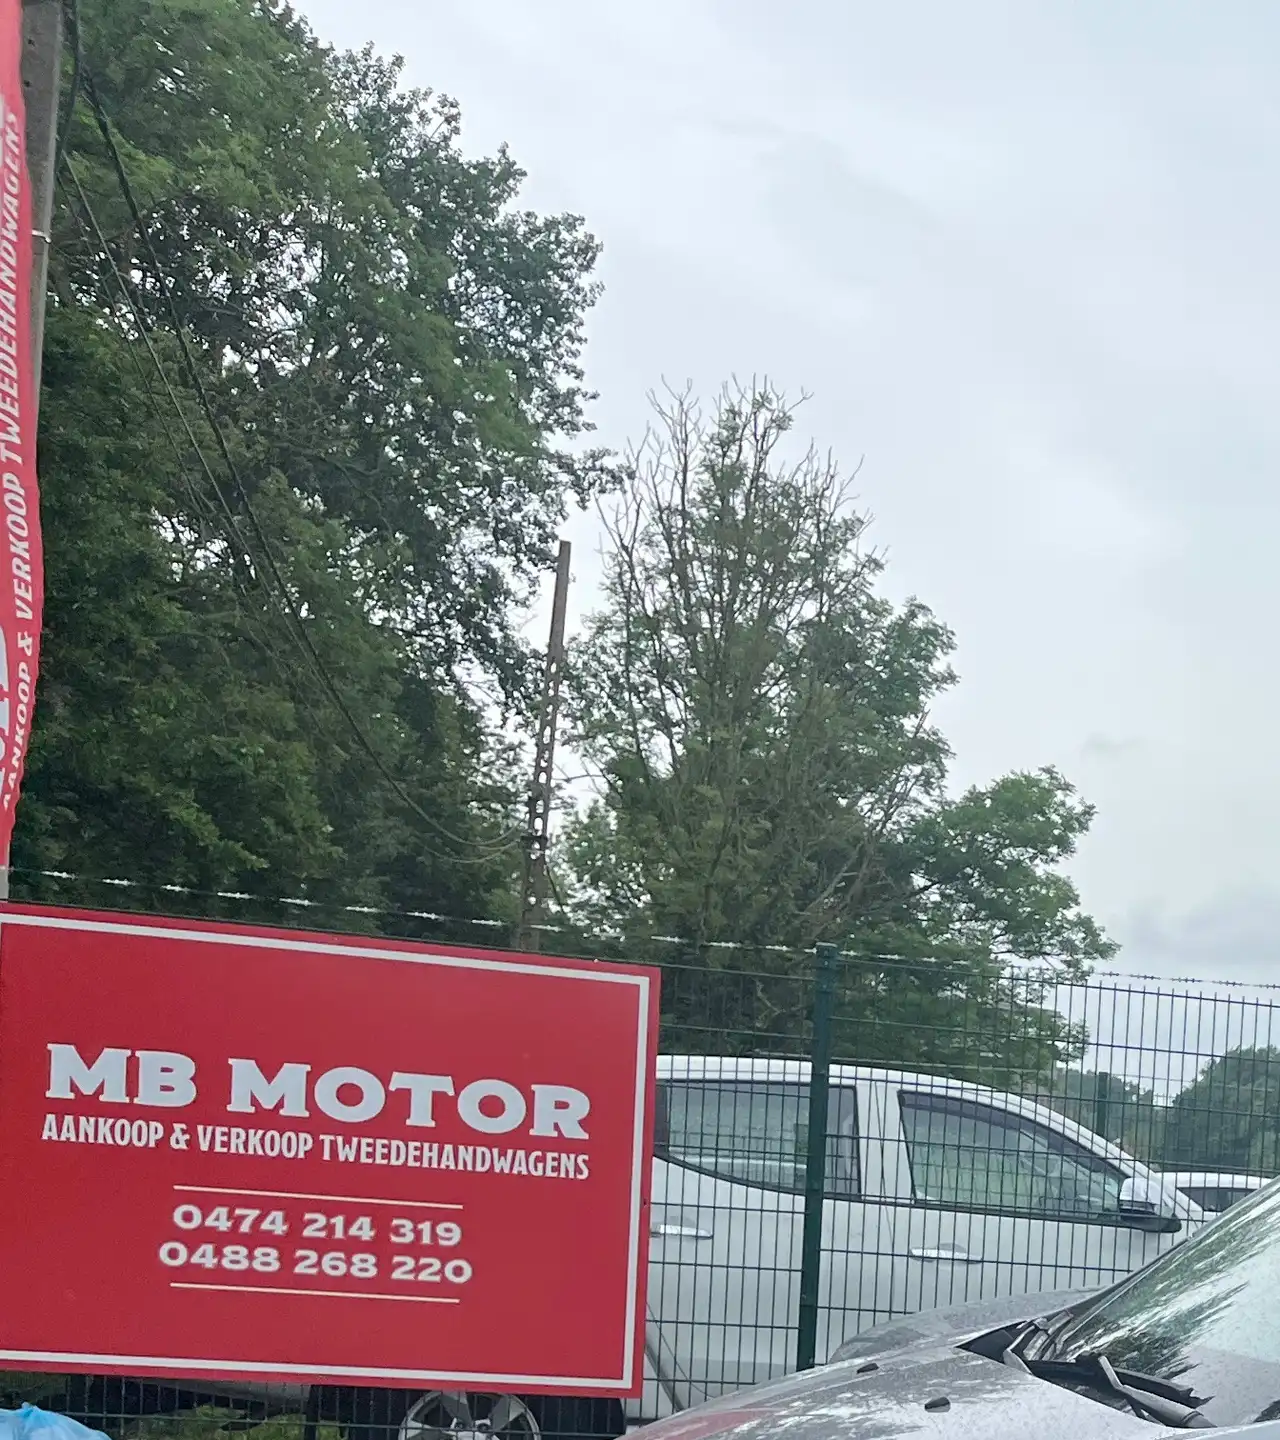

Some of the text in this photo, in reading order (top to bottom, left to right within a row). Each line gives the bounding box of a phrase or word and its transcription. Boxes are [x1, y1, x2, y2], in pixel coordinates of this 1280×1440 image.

[2, 472, 33, 620] VERKOOP
[17, 630, 33, 657] &
[45, 1043, 591, 1140] MB MOTOR
[41, 1113, 590, 1180] AANKOOP & VERKOOP TWEEDEHANDWAGENS
[172, 1203, 463, 1247] 0474 214 319
[158, 1241, 473, 1284] 0488 268 220
